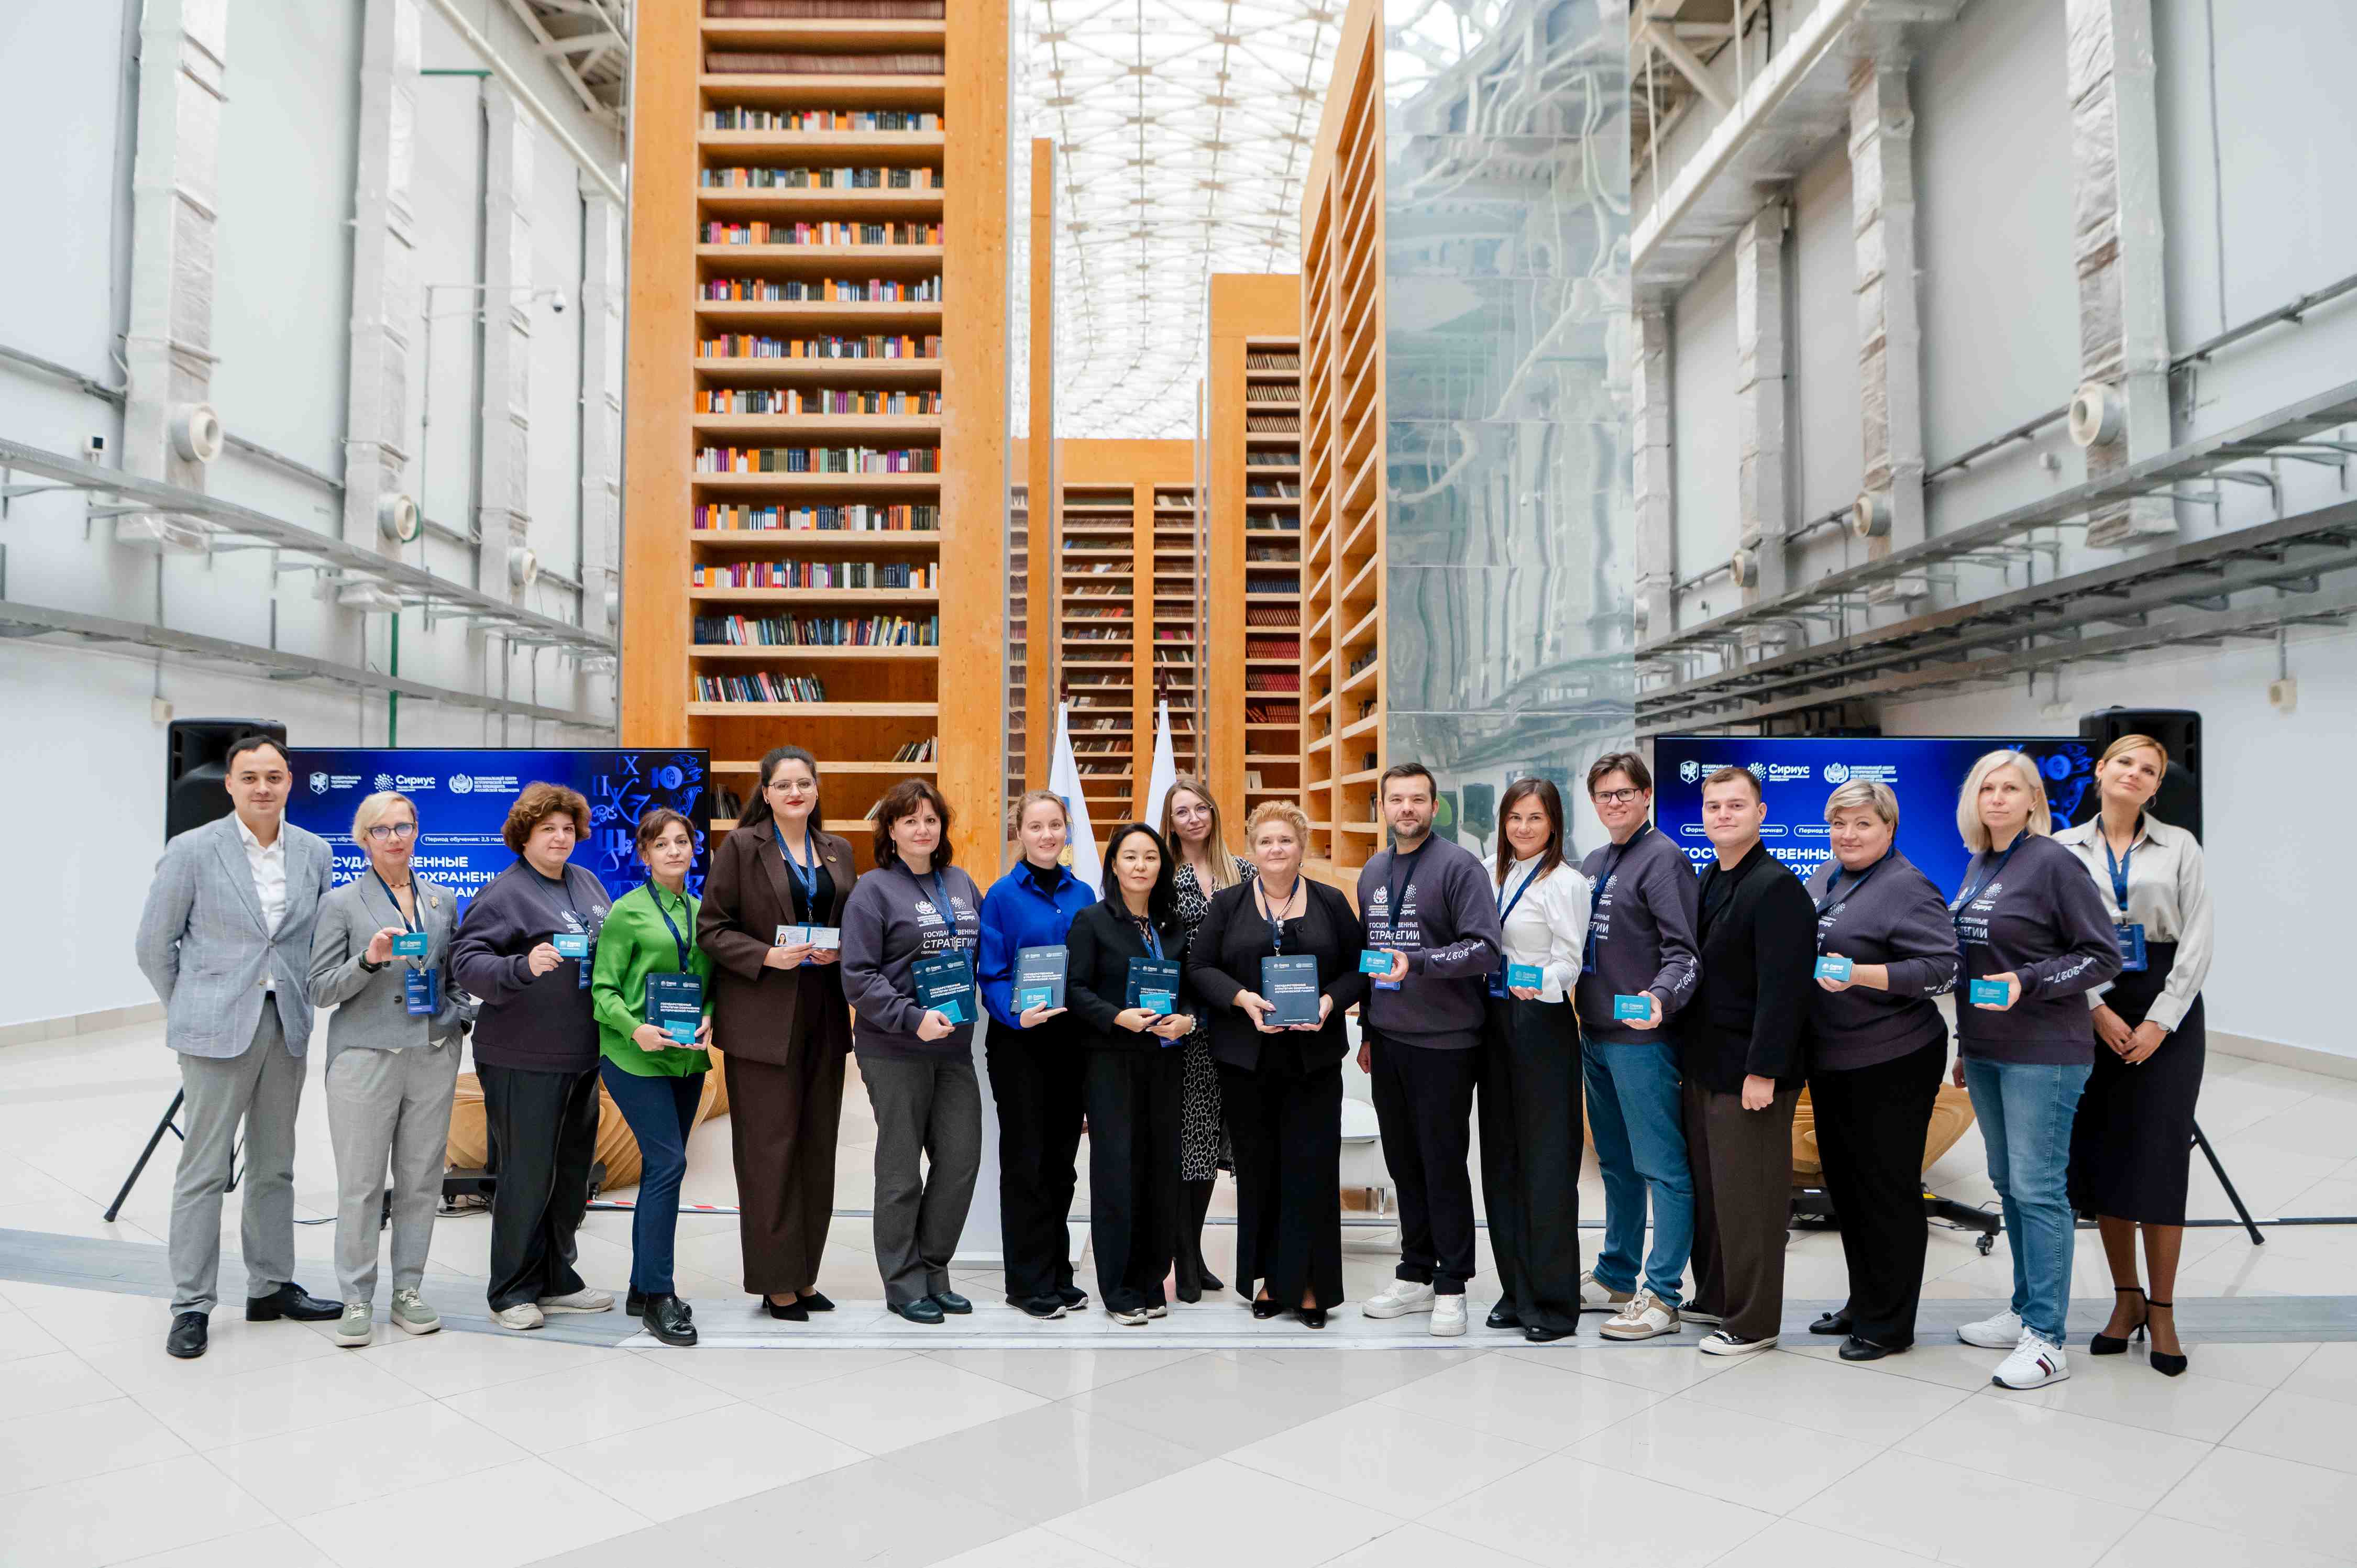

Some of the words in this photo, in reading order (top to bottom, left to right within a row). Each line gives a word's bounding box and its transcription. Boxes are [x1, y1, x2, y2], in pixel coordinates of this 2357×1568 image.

[1769, 764, 1810, 775] Сириус
[395, 775, 435, 786] Сириус
[1370, 930, 1419, 940] СТРАЕГИИ
[1446, 947, 1470, 961] 2027
[2053, 966, 2080, 984] 2027
